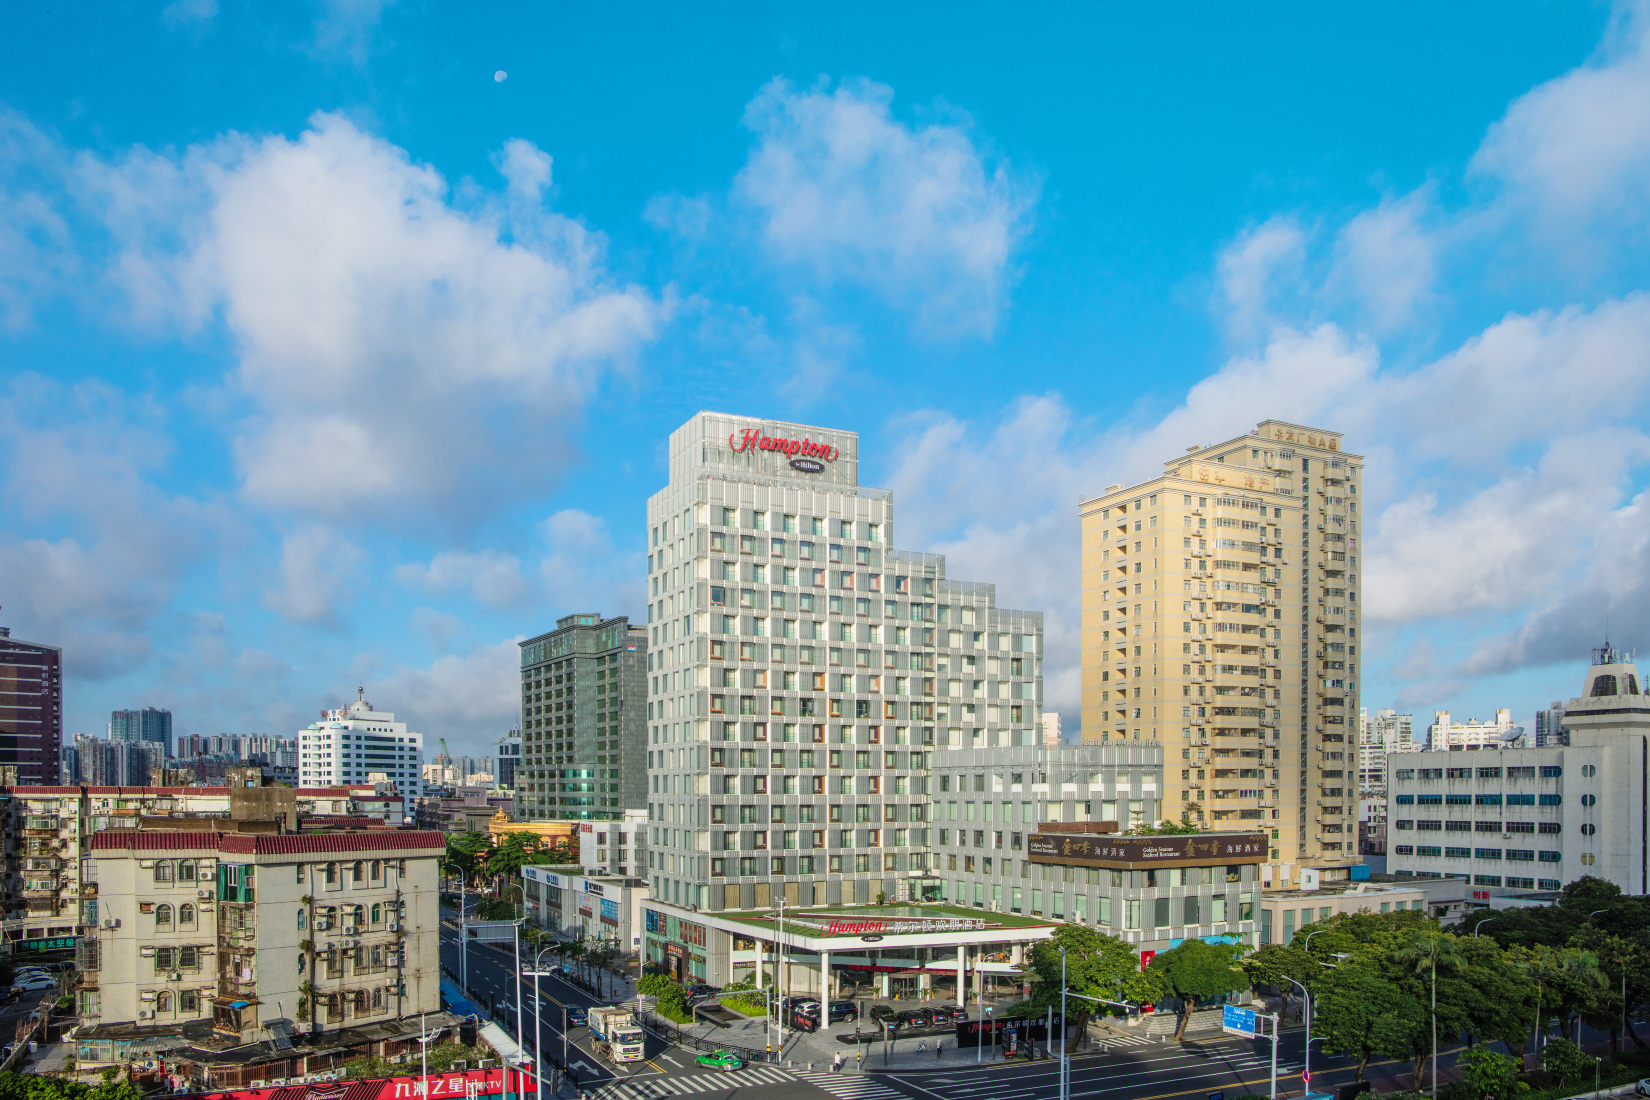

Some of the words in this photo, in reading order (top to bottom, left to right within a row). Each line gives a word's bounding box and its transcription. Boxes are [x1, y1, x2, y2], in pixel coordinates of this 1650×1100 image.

[730, 428, 838, 461] Hampton
[800, 462, 820, 470] Hilton
[1472, 890, 1490, 900] 创新
[820, 919, 888, 937] Hampton
[893, 918, 986, 935] 希尔顿欢朋酒店
[1006, 1016, 1060, 1028] 希尔顿欢朋店
